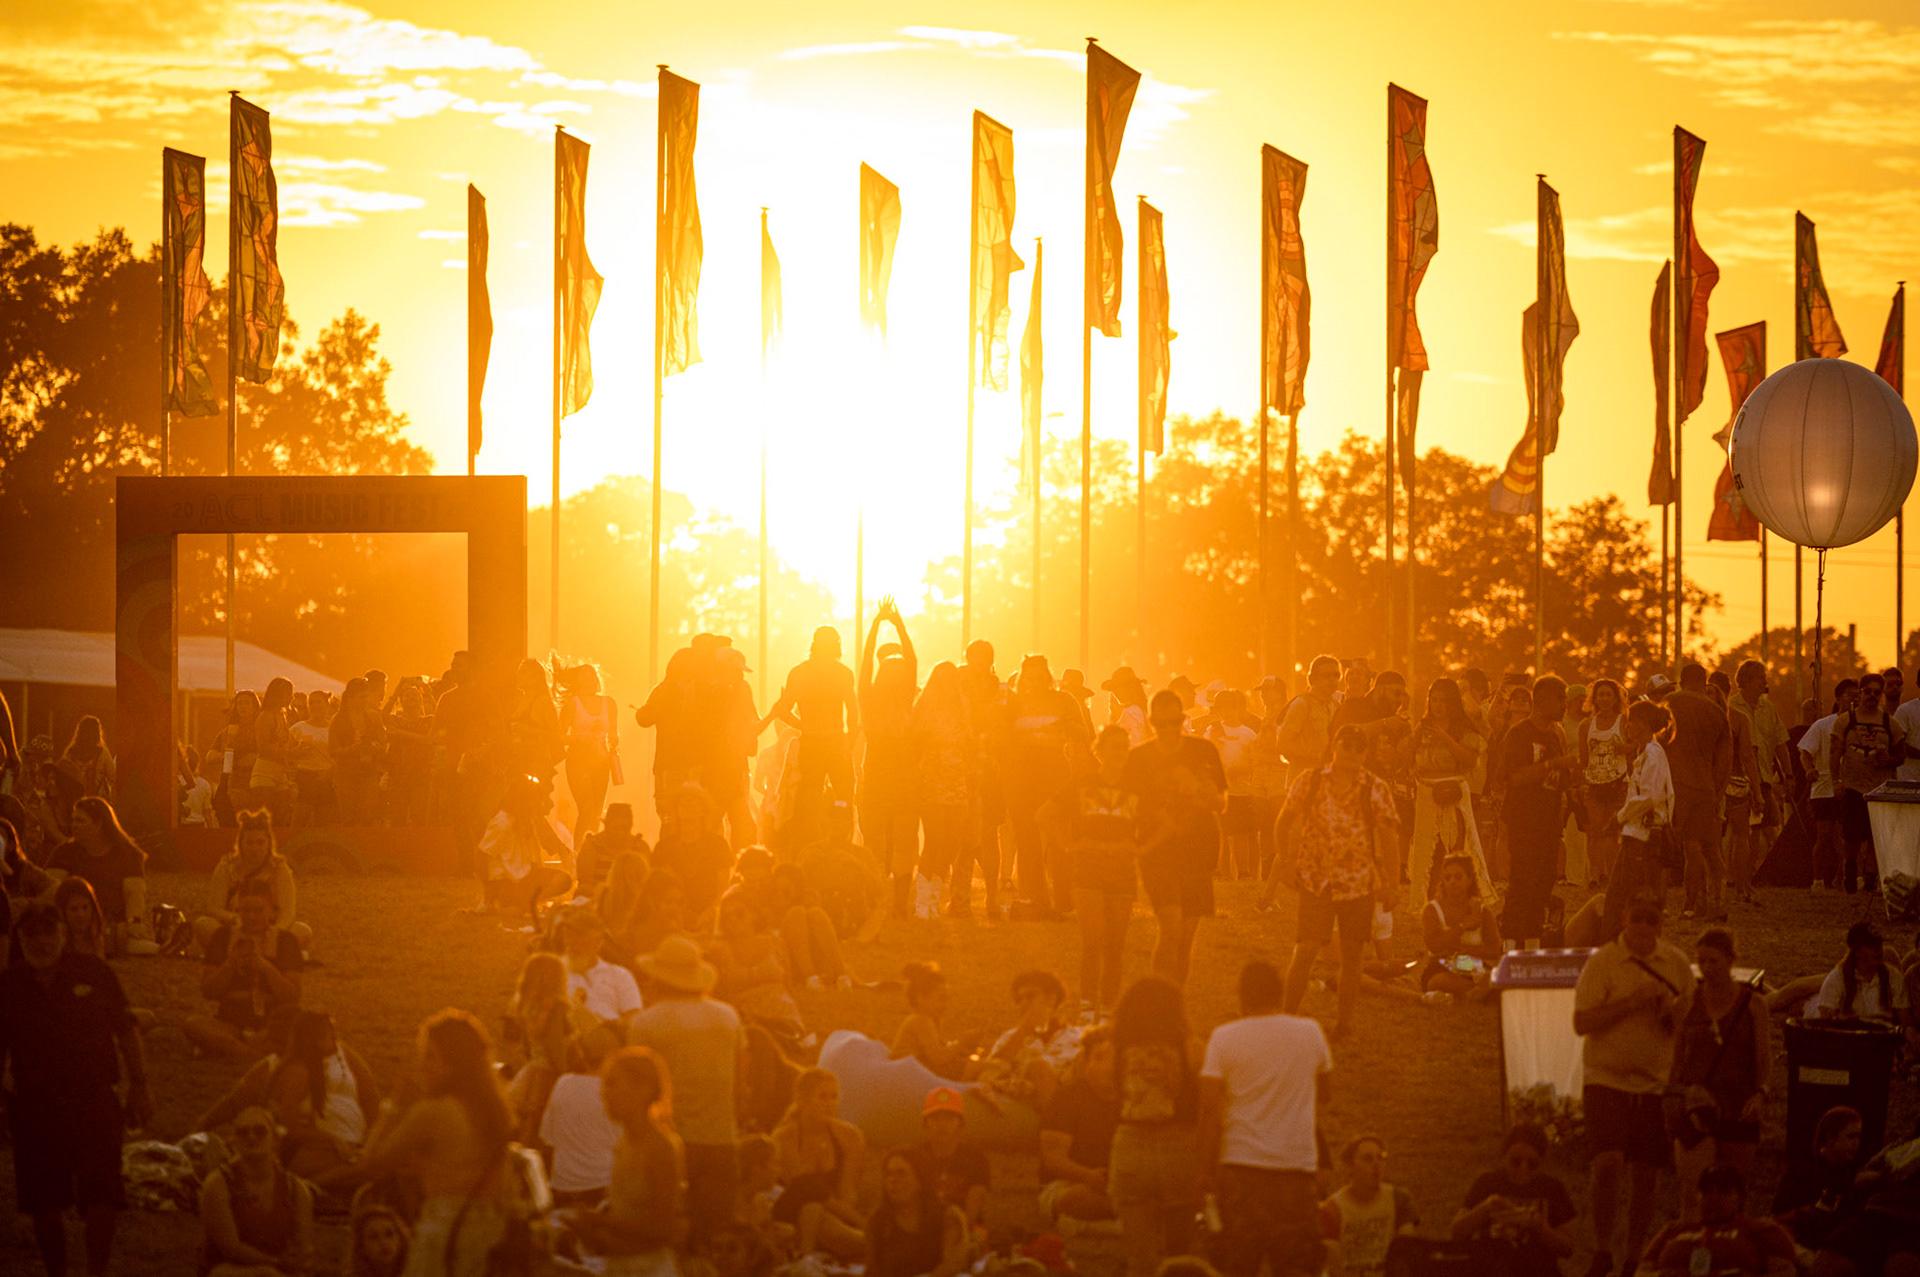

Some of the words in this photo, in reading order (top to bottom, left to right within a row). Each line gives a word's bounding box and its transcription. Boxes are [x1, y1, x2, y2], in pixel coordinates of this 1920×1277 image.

[199, 492, 273, 526] ACL
[279, 493, 370, 526] MUSIC
[378, 493, 441, 526] FEST
